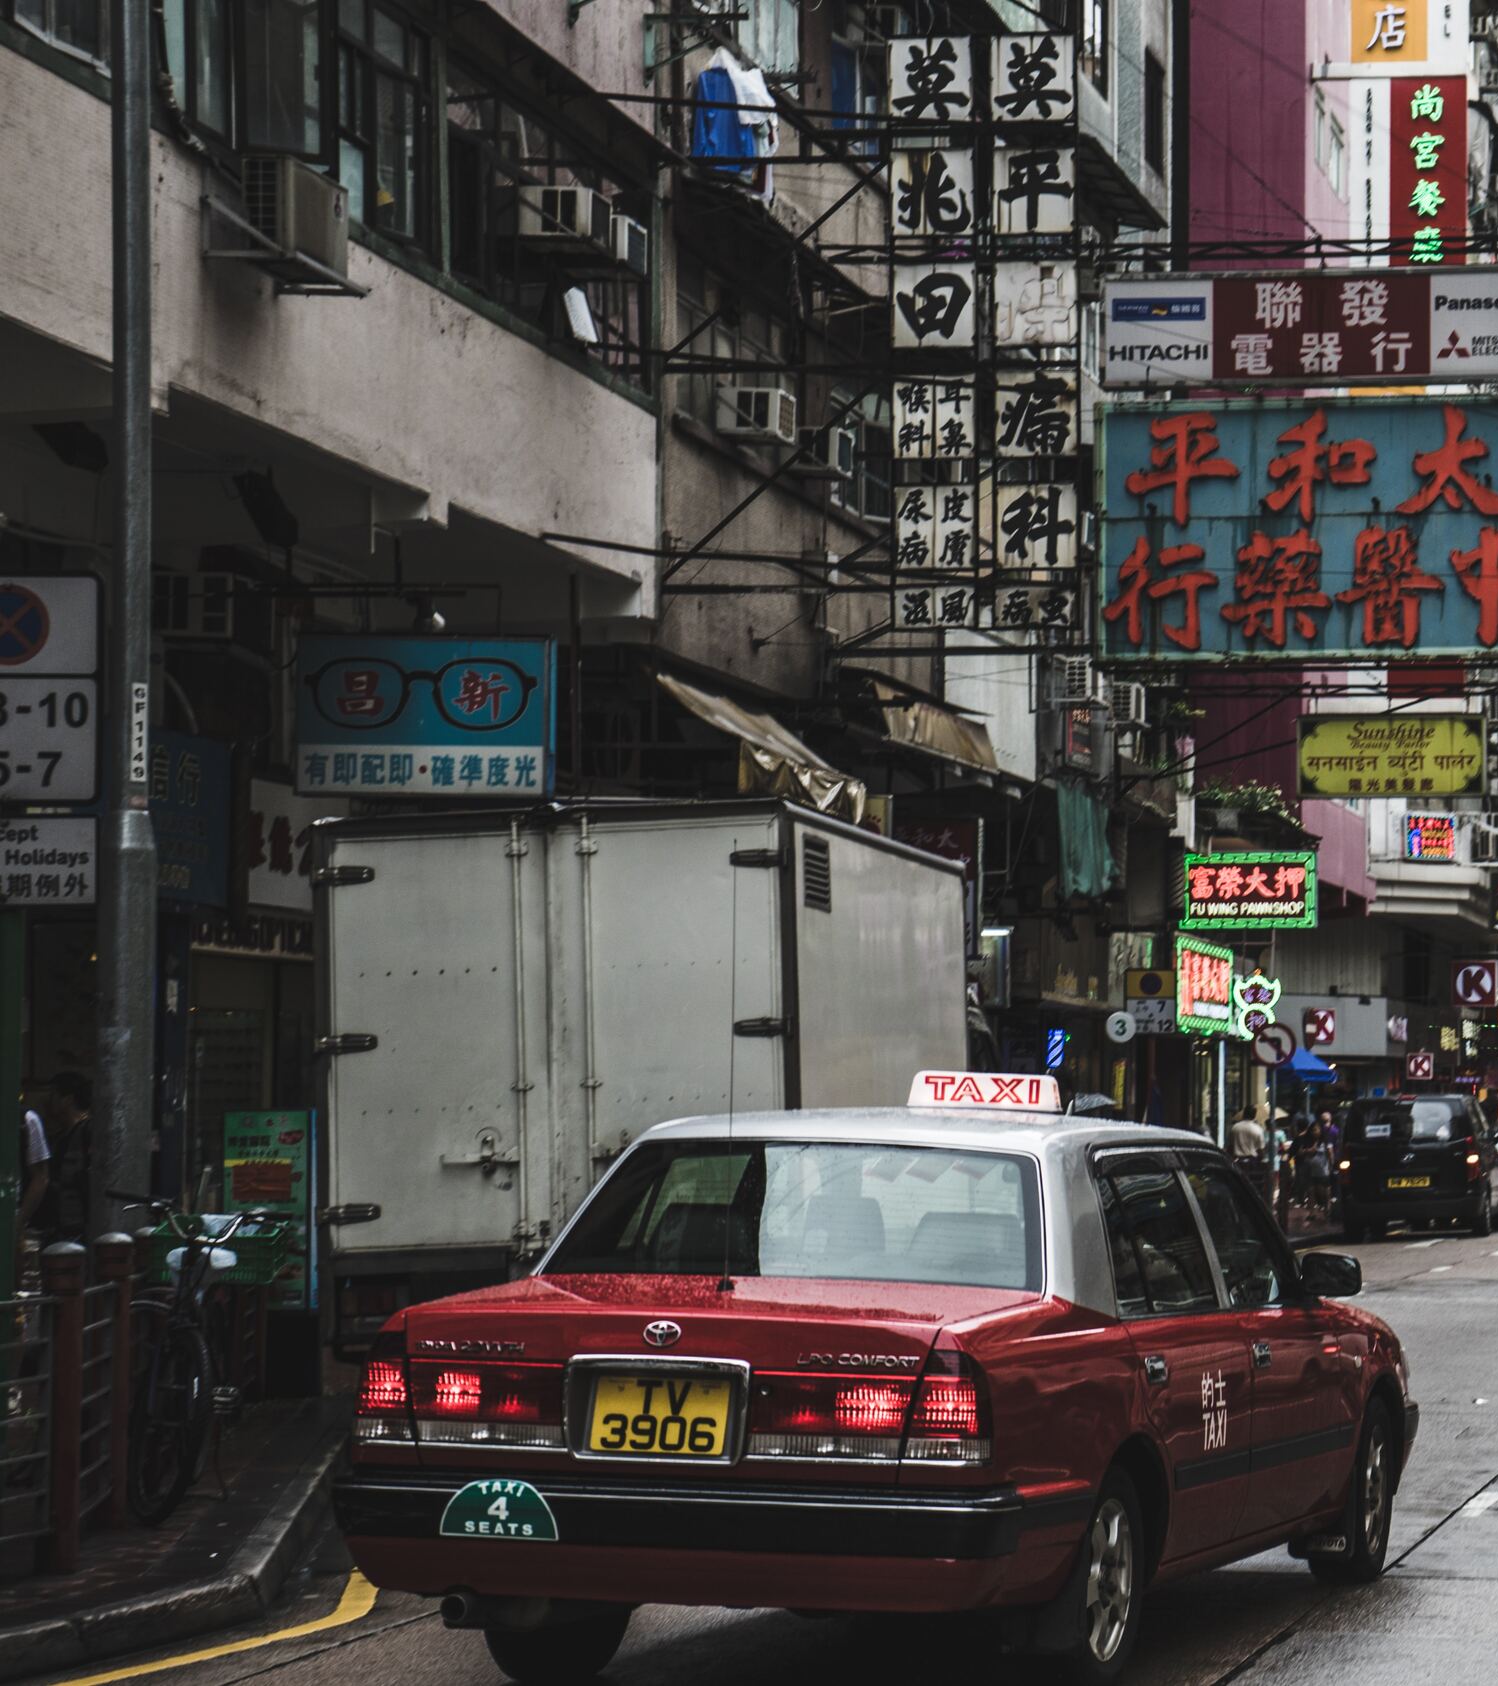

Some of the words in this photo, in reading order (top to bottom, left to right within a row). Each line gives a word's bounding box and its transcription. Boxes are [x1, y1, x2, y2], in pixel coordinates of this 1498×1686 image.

[1365, 3, 1407, 50] 店
[1109, 343, 1209, 363] HITACHI
[1231, 331, 1414, 375] 電器行
[1347, 719, 1435, 741] Sunshine
[5, 847, 90, 870] Holidays
[1189, 865, 1306, 900] 富榮大押
[1190, 902, 1207, 916] FU
[1207, 902, 1238, 916] WING
[1240, 901, 1305, 916] PAWNSHOP
[1114, 1019, 1127, 1036] 3
[1157, 1019, 1173, 1032] 12
[925, 1075, 1041, 1106] TAXI
[838, 1352, 920, 1368] COMFORT
[637, 1379, 693, 1415] TV
[1201, 1369, 1226, 1409] 的士
[601, 1413, 717, 1452] 3906
[1202, 1409, 1227, 1450] TAXI
[477, 1481, 526, 1498] TAXI
[487, 1496, 509, 1520] 4
[464, 1520, 534, 1536] SEATS
